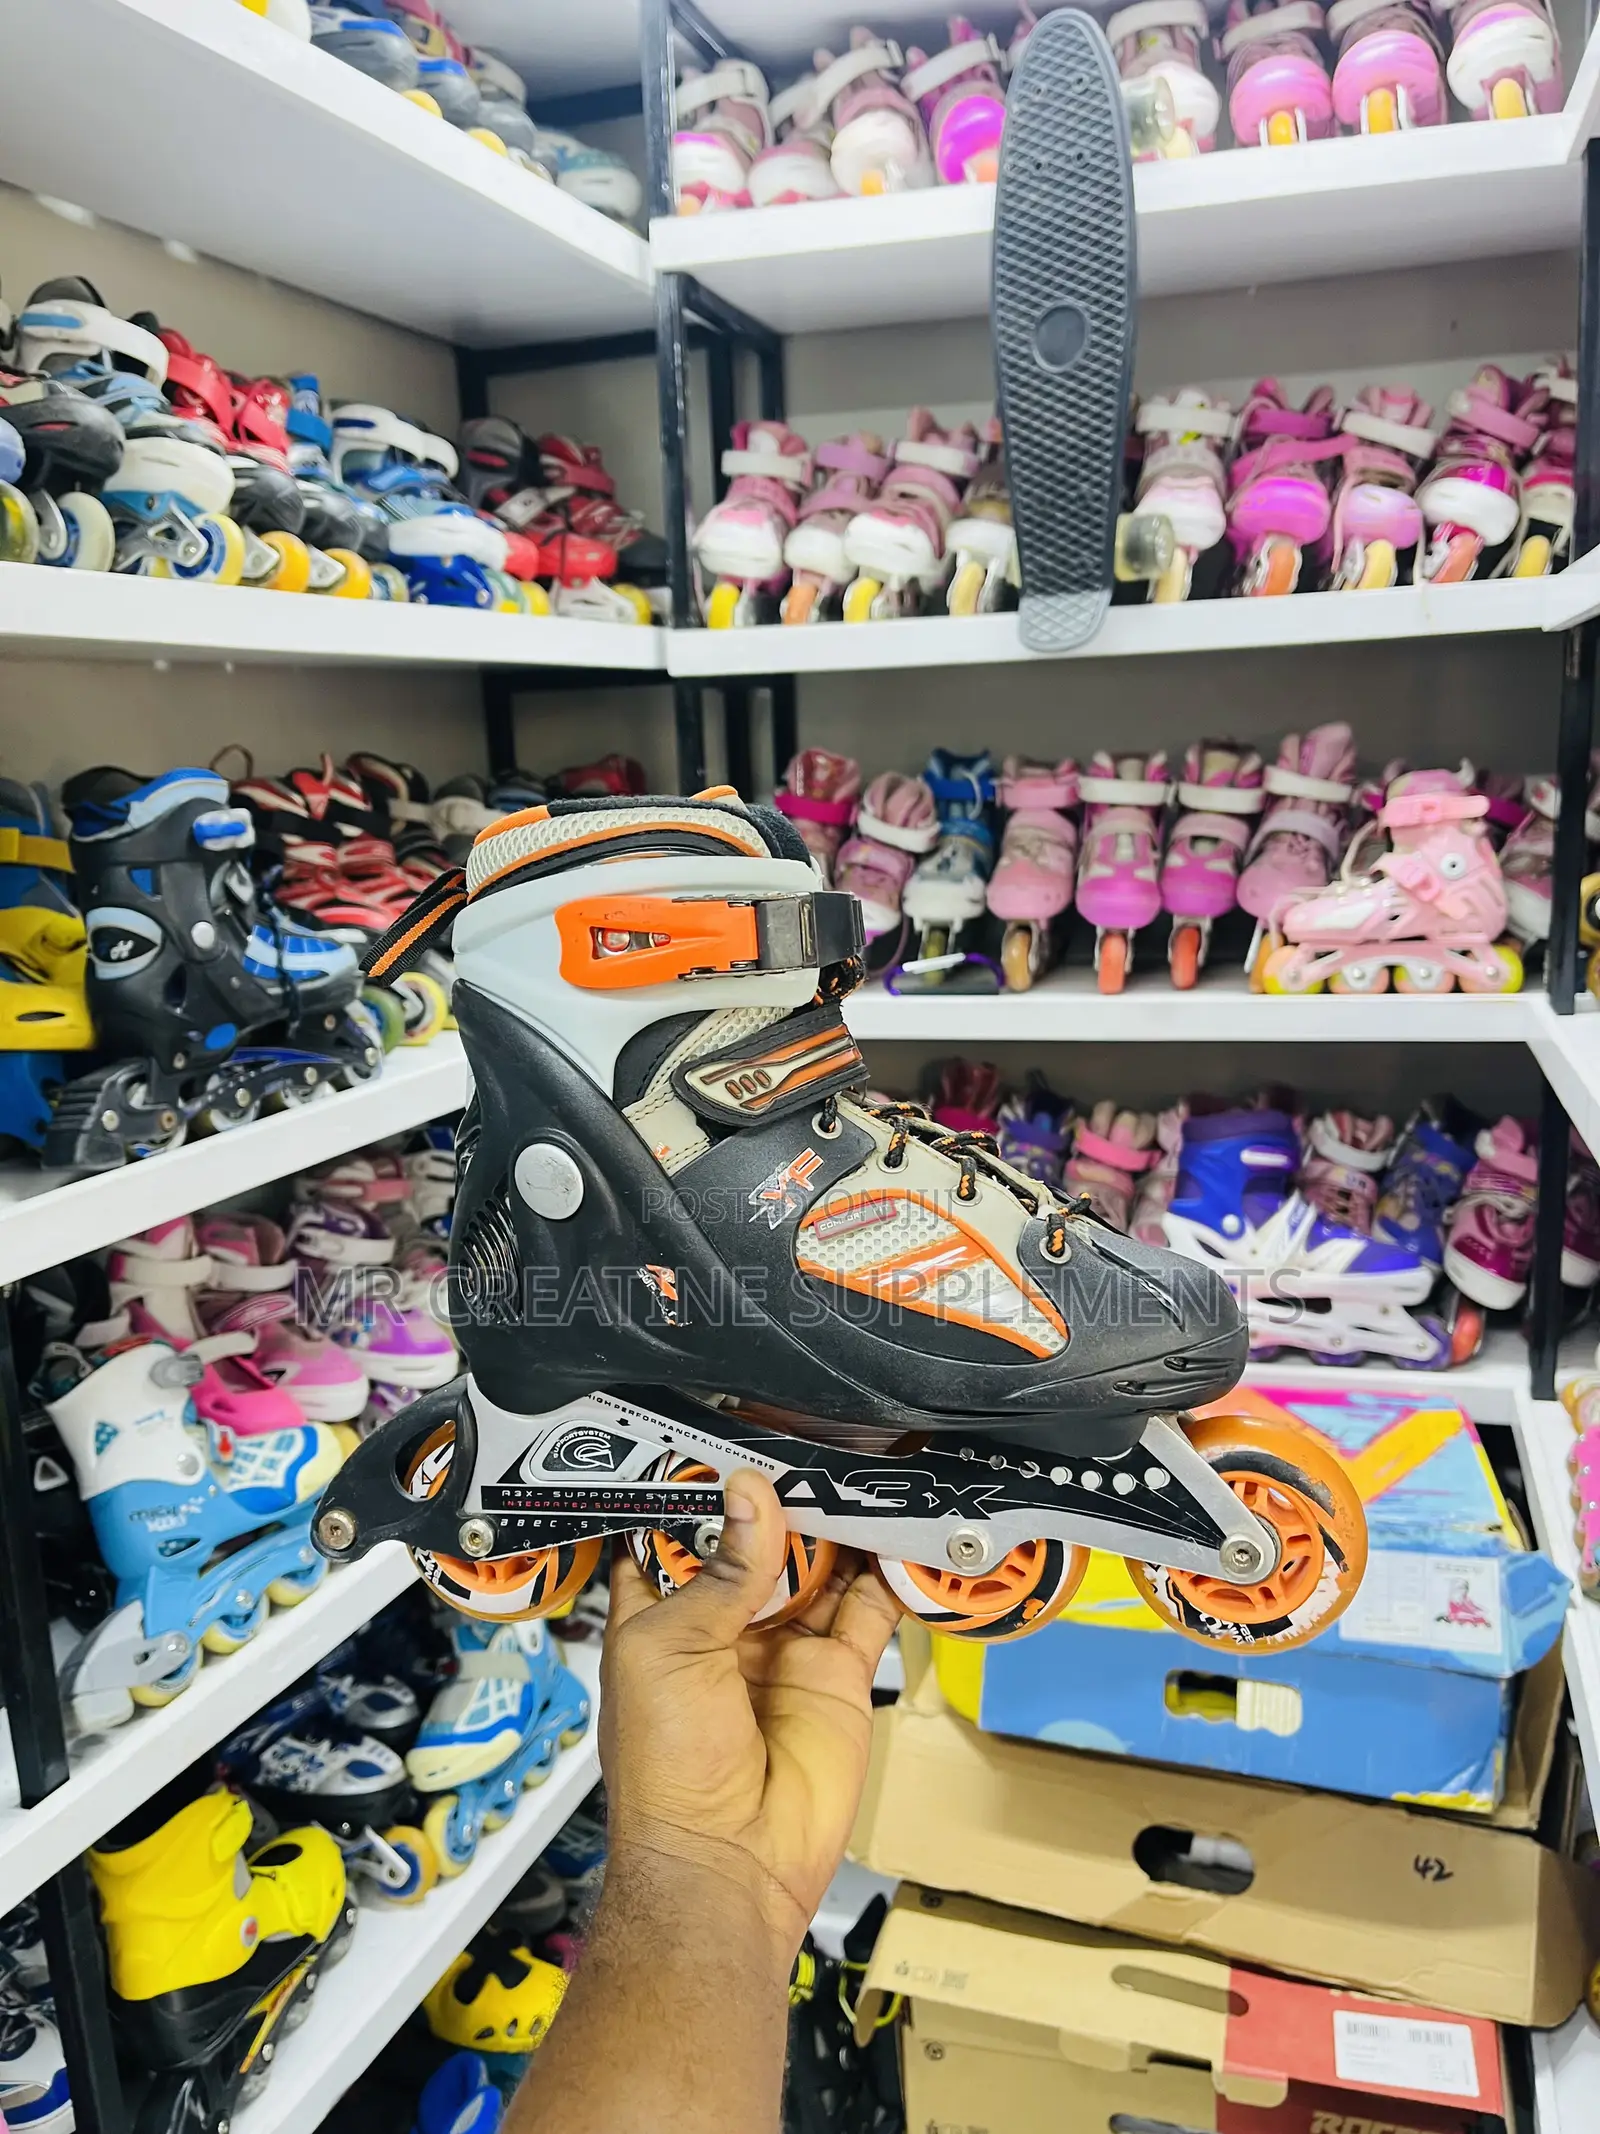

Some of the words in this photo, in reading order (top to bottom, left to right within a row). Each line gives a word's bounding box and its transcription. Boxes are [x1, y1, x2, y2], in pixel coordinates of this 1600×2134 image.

[614, 1403, 698, 1441] PERFORMANCE
[724, 1447, 775, 1471] CHASSIS
[502, 1500, 587, 1509] INTEGRATED
[594, 1501, 660, 1510] SUPPORT
[667, 1503, 713, 1512] BRACE
[552, 1490, 636, 1500] SUPPORT
[645, 1492, 717, 1501] SYSTEM
[773, 1468, 1005, 1520] A3X
[1413, 1854, 1454, 1882] 42
